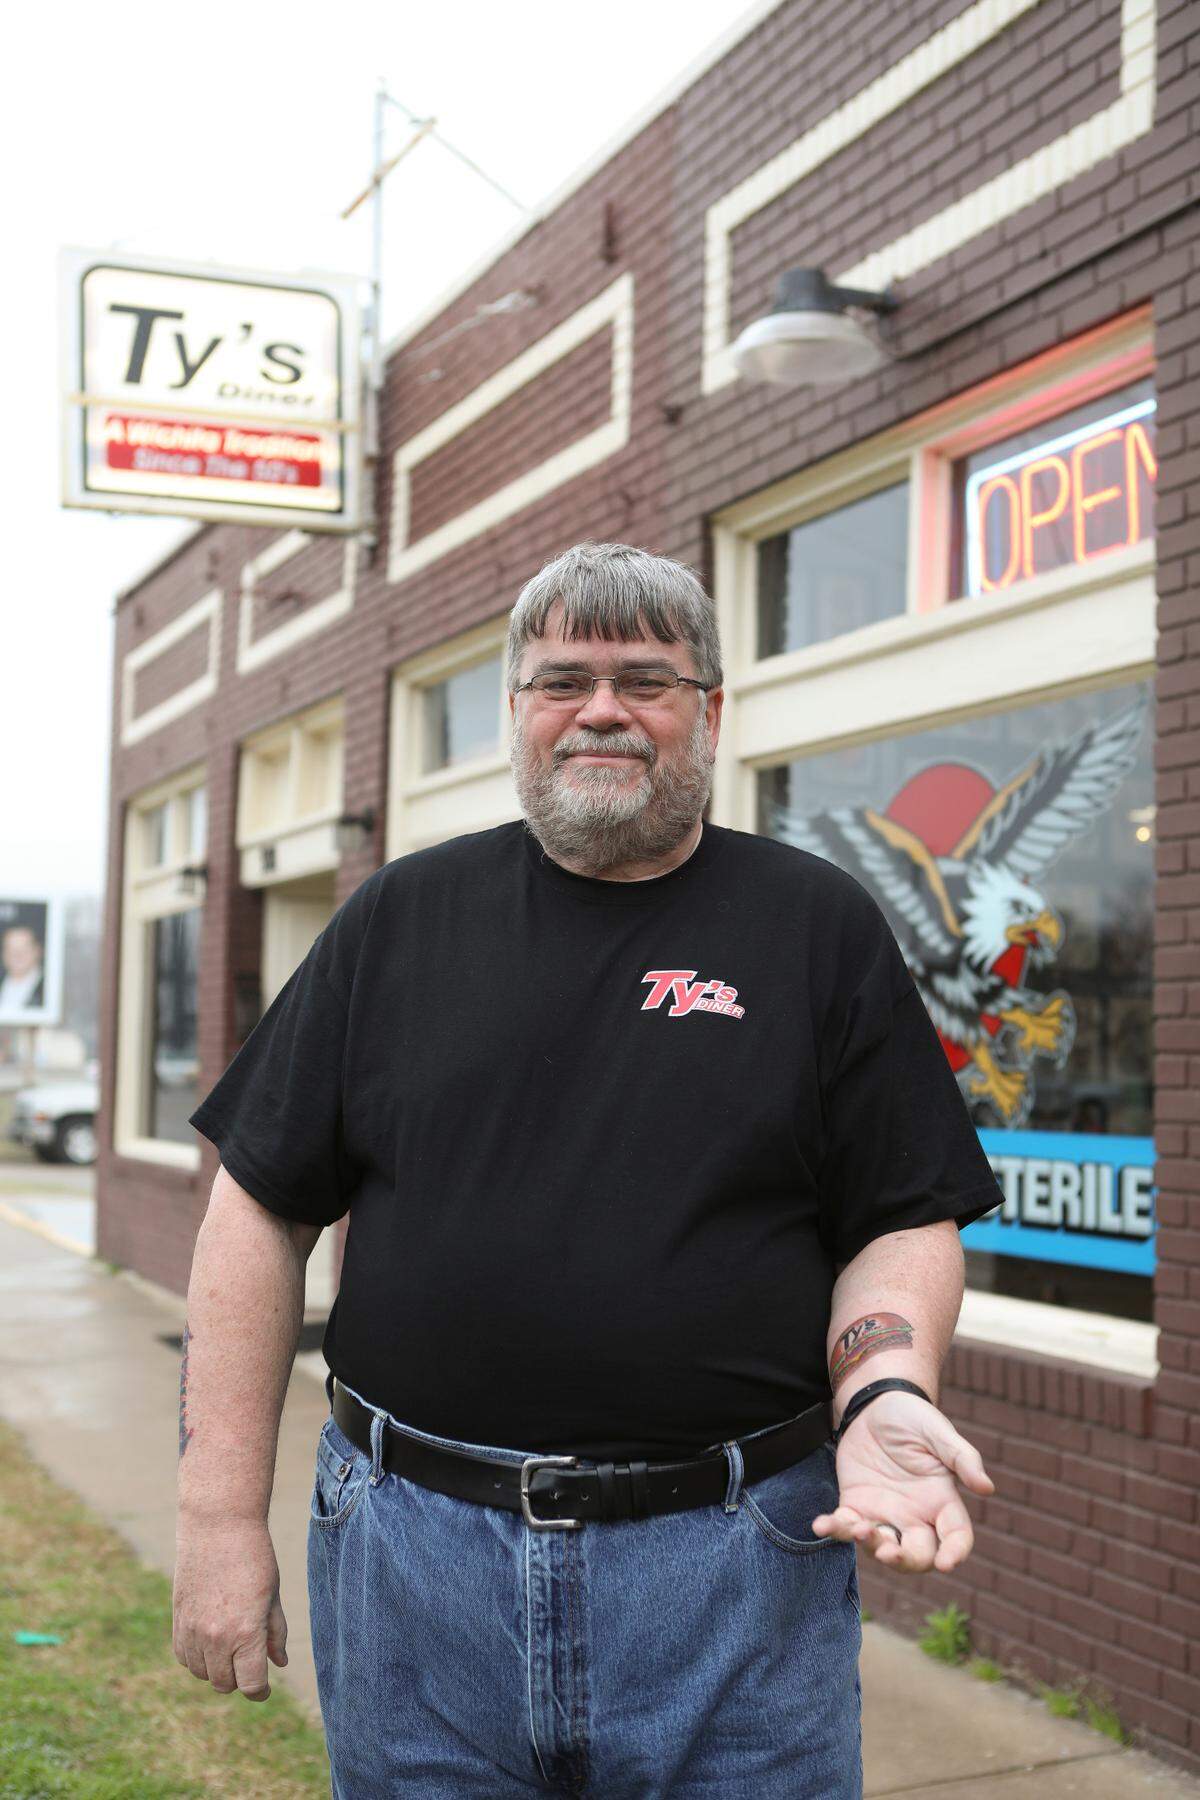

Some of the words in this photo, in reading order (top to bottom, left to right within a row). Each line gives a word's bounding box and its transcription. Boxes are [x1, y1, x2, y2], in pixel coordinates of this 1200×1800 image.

[109, 303, 304, 389] Ty's
[217, 382, 314, 405] Diner
[133, 446, 202, 473] Since
[206, 453, 249, 478] The
[640, 969, 738, 1016] Ty's
[694, 998, 745, 1019] DINER
